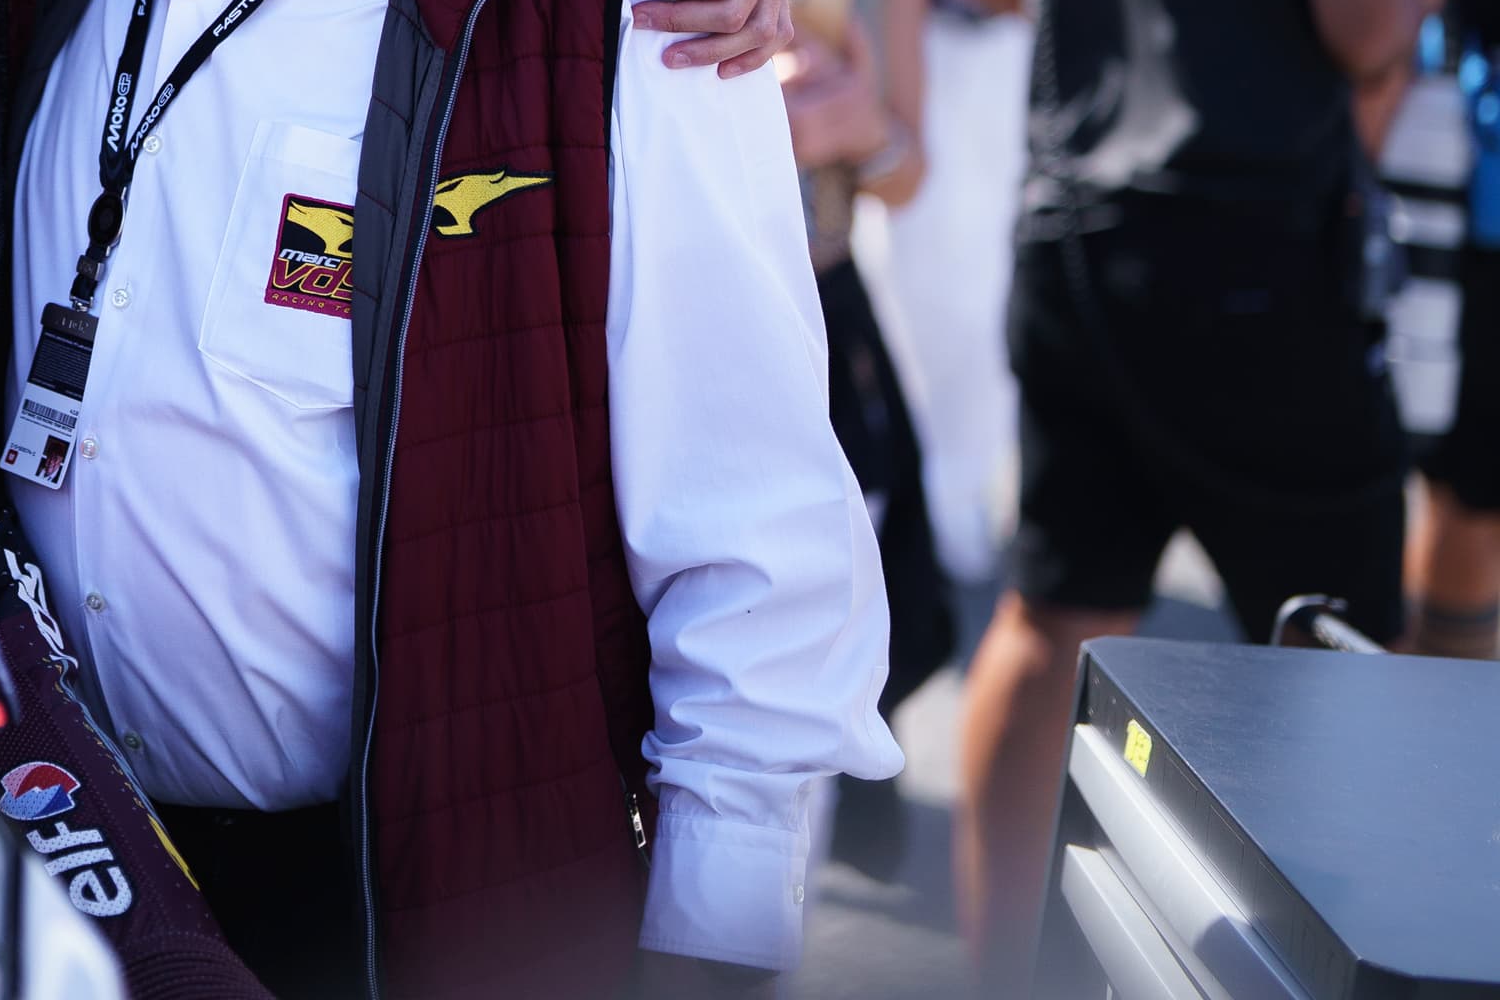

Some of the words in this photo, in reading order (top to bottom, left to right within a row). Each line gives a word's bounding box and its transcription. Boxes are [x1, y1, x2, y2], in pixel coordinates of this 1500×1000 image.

[279, 248, 342, 268] marc
[271, 293, 326, 309] RACING
[334, 305, 351, 314] TE
[26, 820, 133, 918] elf
